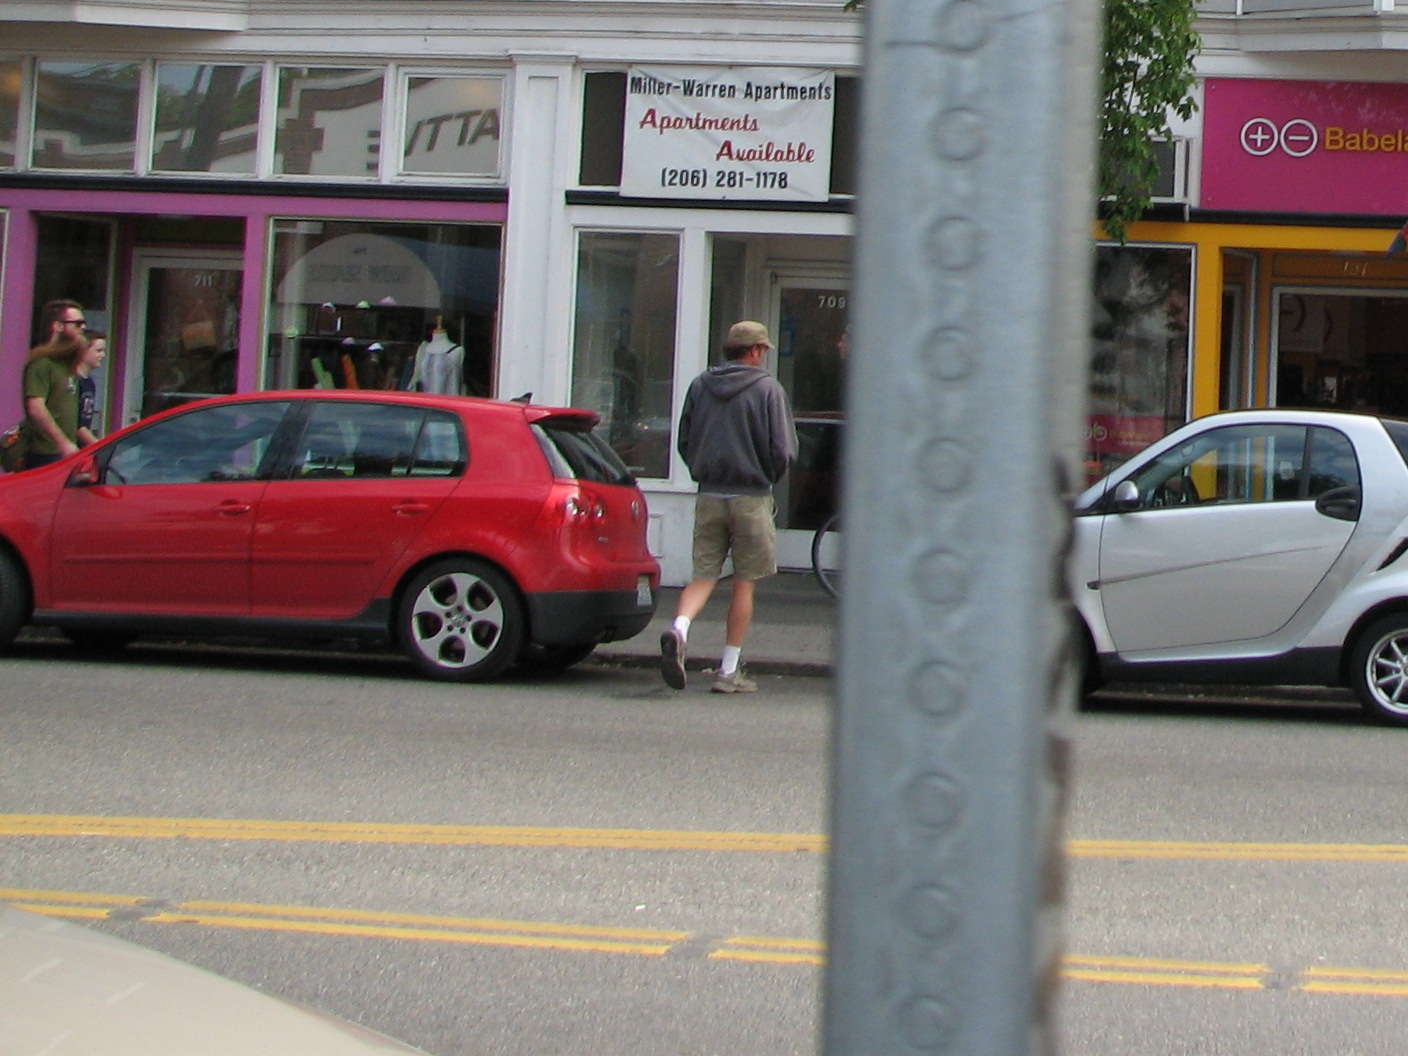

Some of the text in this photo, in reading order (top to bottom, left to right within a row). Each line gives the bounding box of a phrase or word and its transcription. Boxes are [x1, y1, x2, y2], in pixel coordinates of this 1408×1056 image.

[630, 76, 832, 102] Miller-Warren Apartments
[639, 108, 760, 134] Apartments
[715, 140, 816, 163] Available
[661, 168, 788, 189] (206) 281-1178
